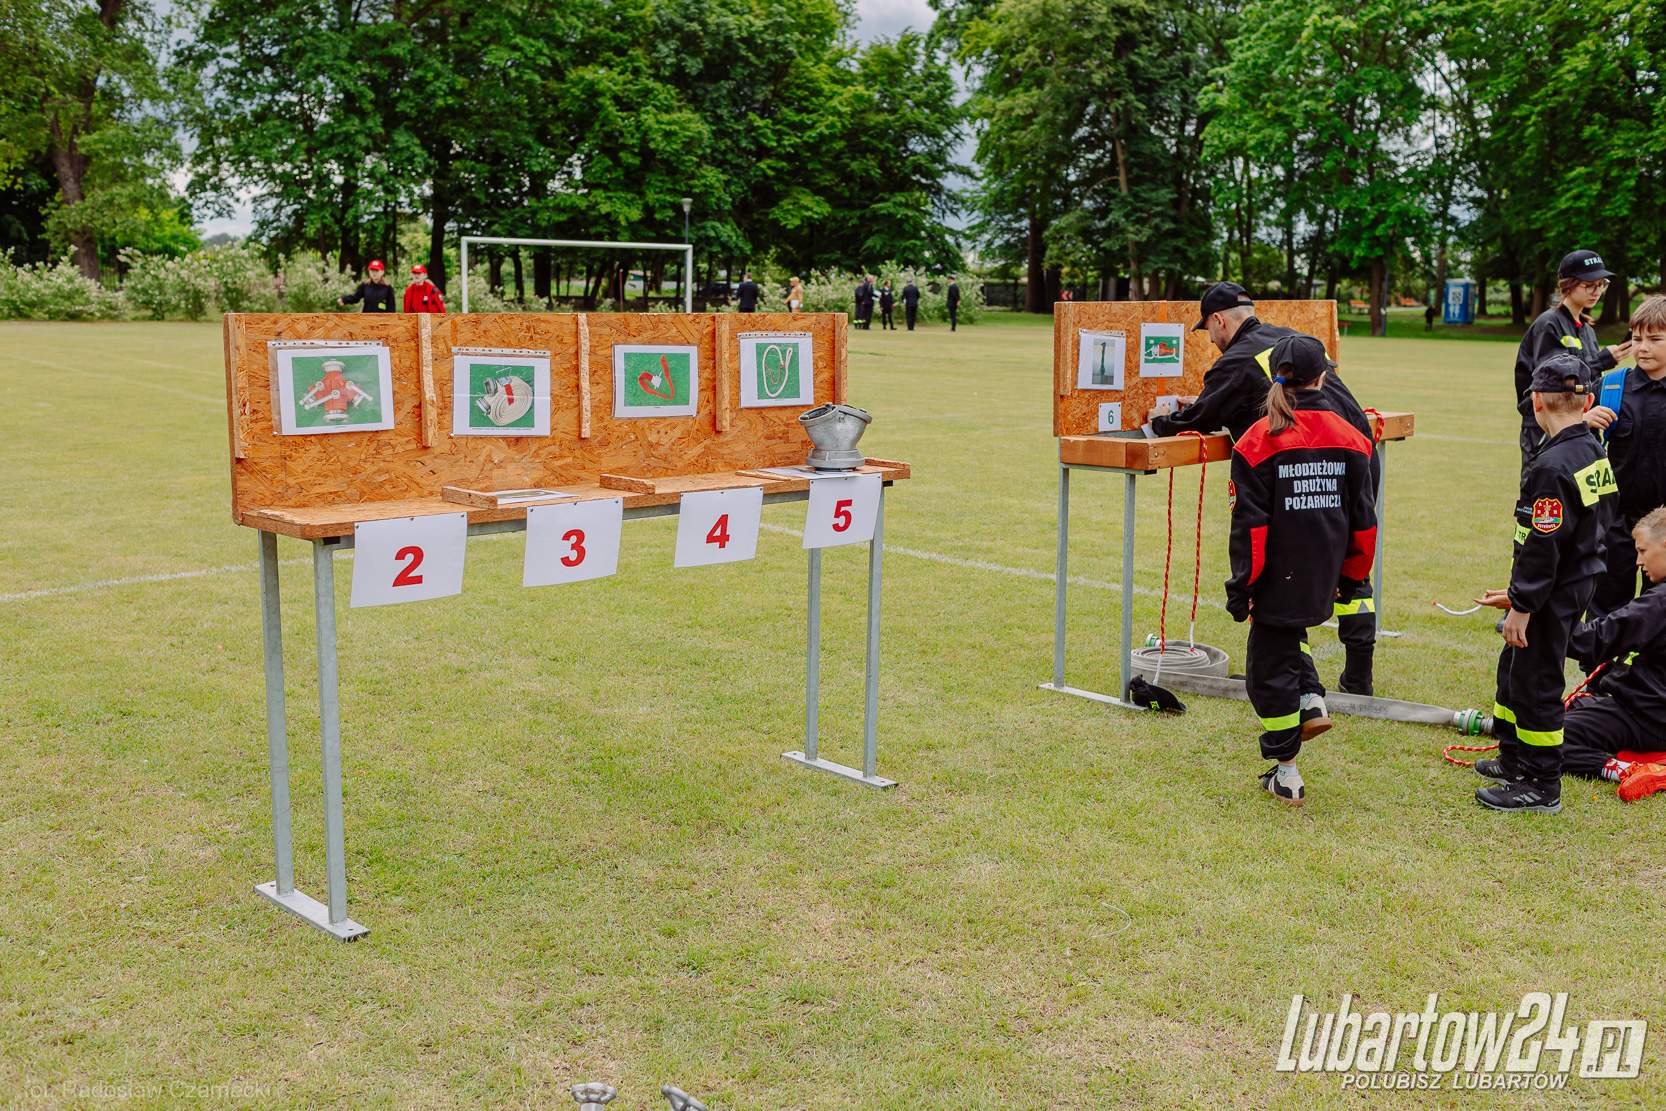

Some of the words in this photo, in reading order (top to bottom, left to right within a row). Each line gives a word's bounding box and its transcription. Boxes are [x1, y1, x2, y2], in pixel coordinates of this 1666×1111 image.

[1108, 410, 1114, 425] 6
[1293, 476, 1337, 493] DRUŻYNA
[705, 513, 731, 550] 4
[831, 498, 854, 533] 5
[559, 527, 587, 568] 3
[392, 545, 426, 588] 2
